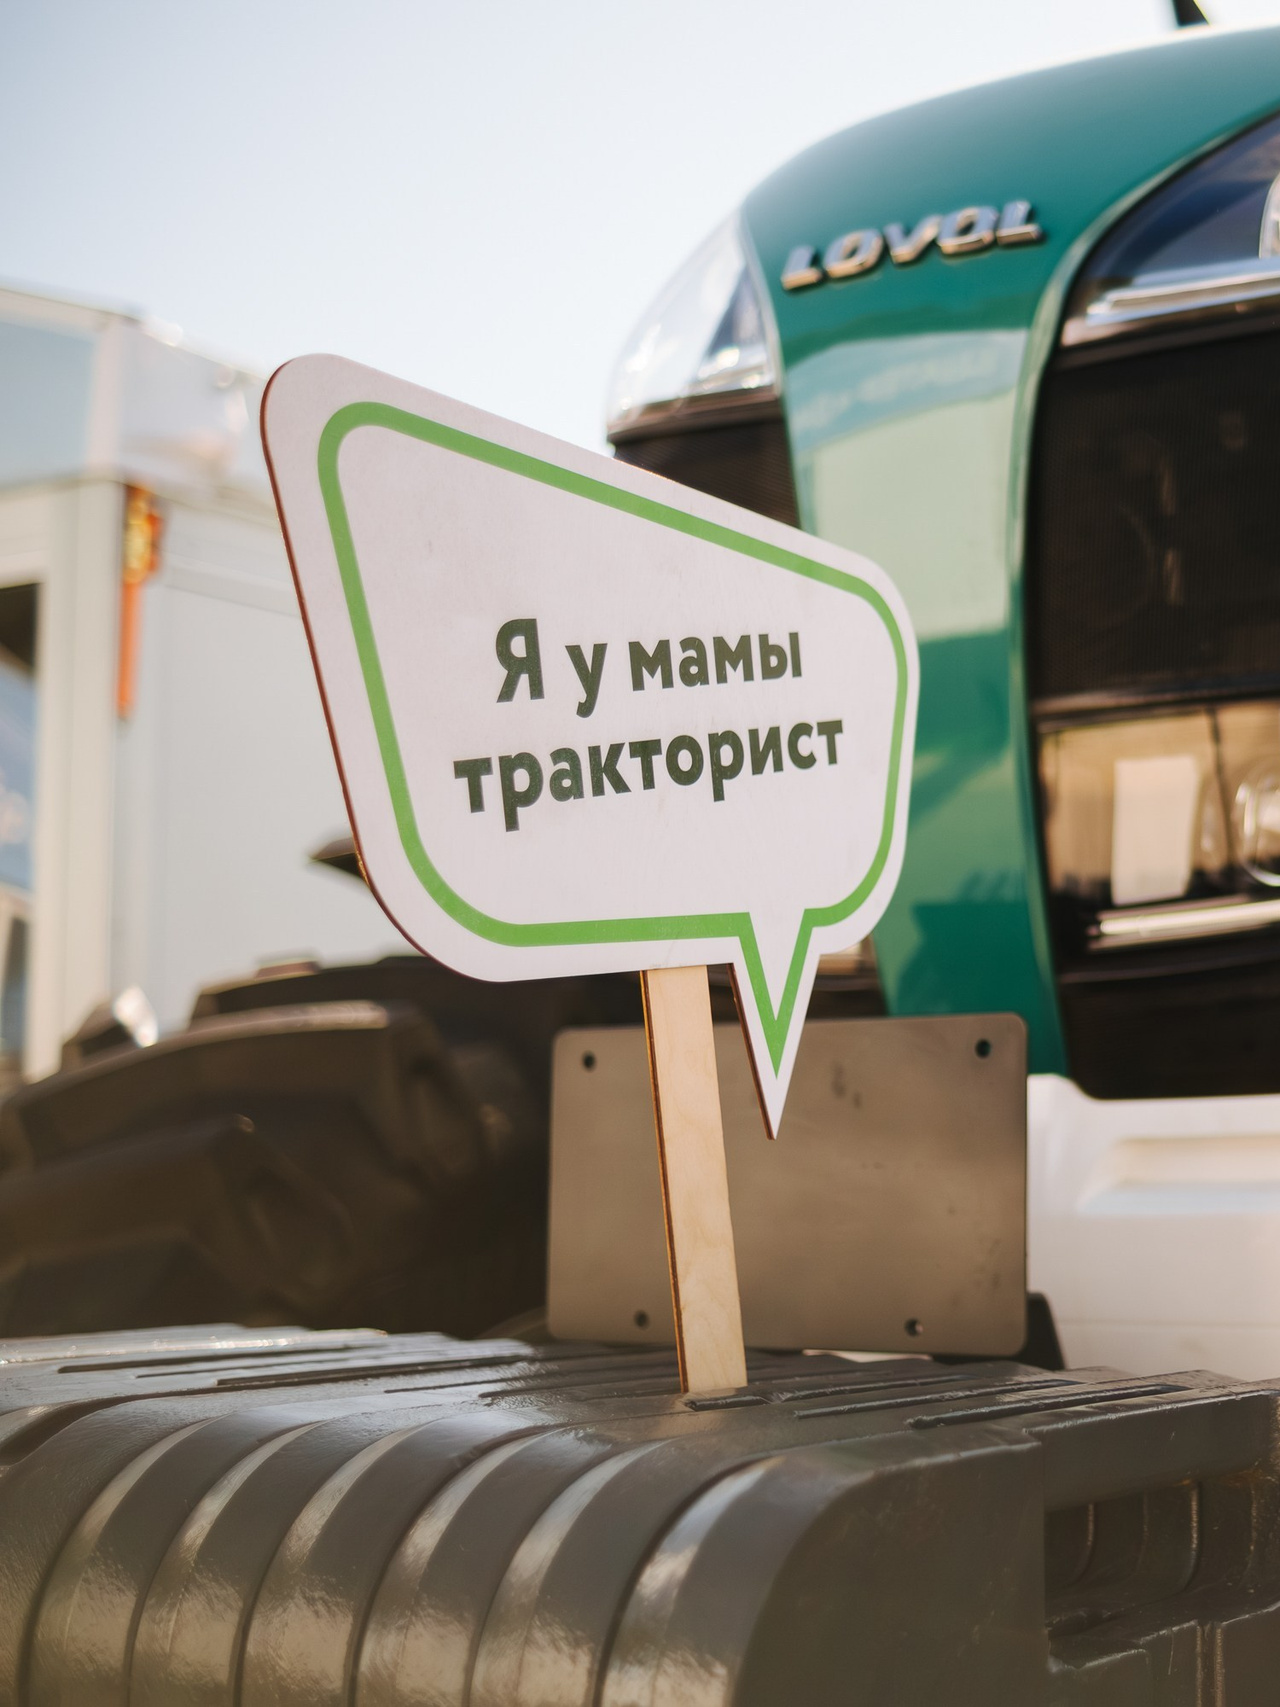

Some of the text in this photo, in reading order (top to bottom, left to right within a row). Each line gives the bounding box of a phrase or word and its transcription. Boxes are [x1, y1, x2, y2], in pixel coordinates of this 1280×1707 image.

[781, 200, 1041, 291] LOVOL
[495, 617, 802, 718] Я у мамы
[453, 719, 844, 832] тракторист
